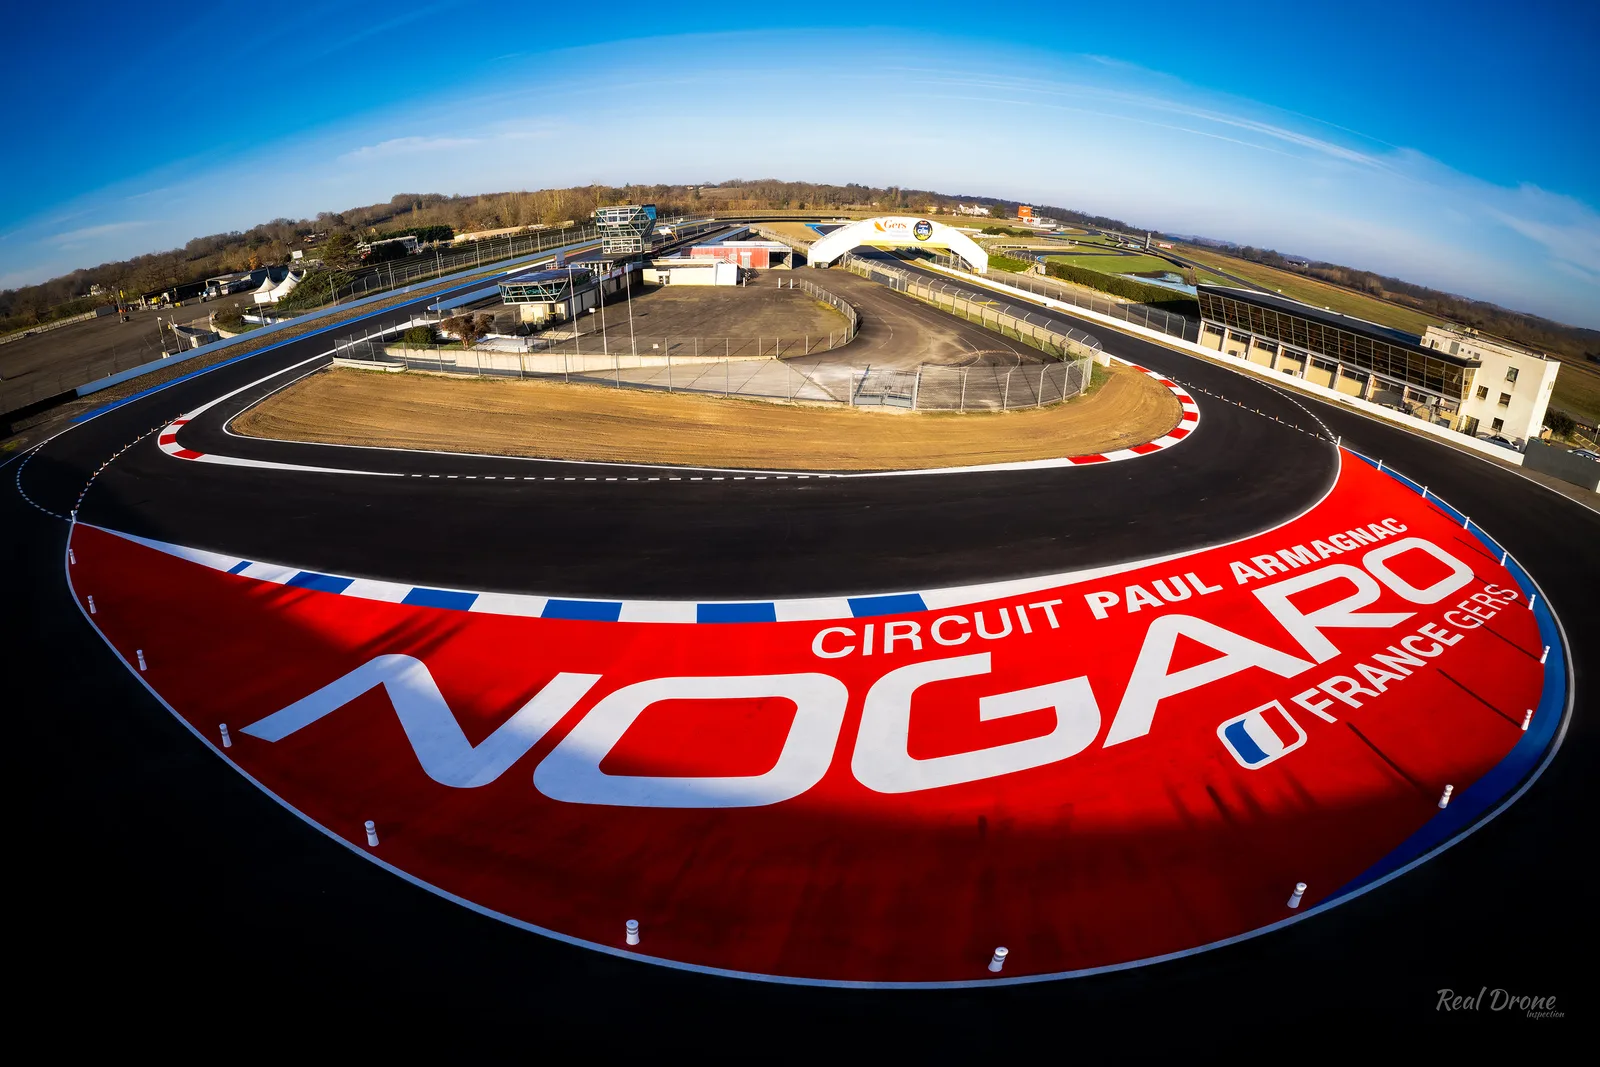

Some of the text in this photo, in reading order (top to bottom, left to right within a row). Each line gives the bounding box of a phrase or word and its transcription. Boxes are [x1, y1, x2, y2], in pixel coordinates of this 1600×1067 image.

[883, 219, 907, 229] Gers
[811, 517, 1408, 659] CIRCUIT PAUL ARMAGNAC
[1290, 583, 1519, 724] FRANCE GERS
[248, 537, 1474, 807] NOGARO
